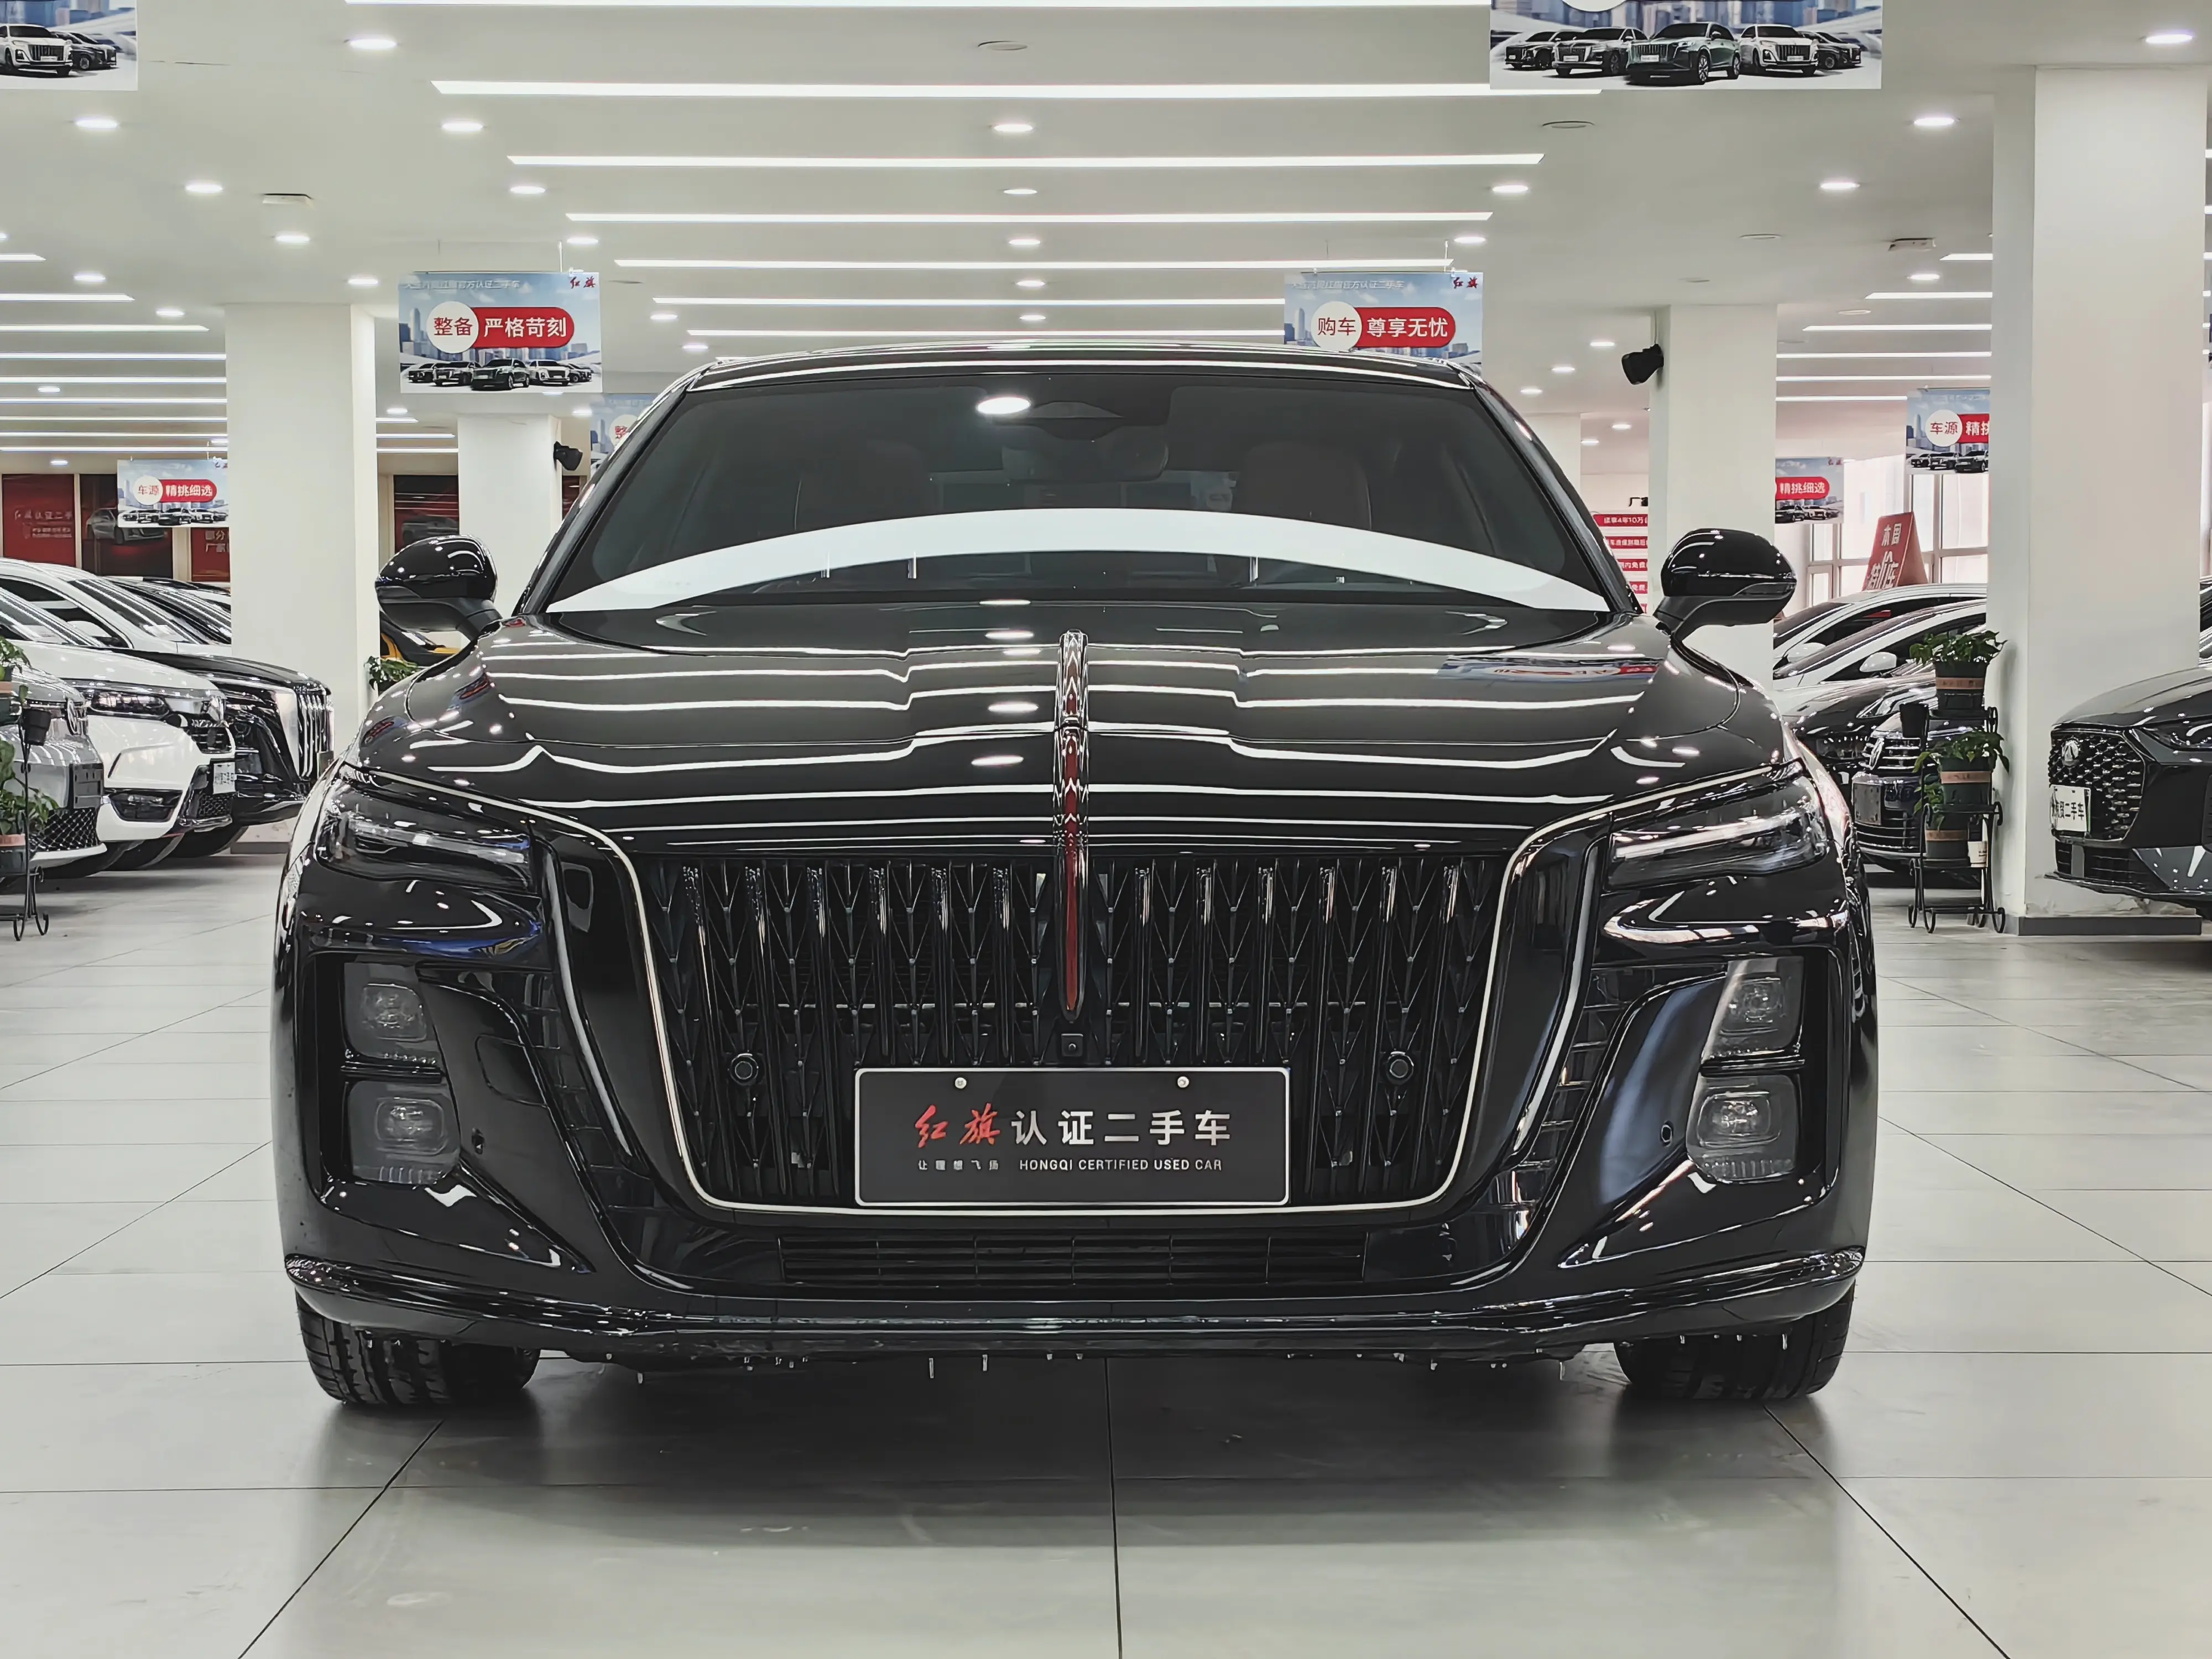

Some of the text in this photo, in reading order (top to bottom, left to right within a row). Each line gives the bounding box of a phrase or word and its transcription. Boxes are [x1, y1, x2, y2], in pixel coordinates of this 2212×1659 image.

[434, 317, 567, 337] 整备 严格苛刻
[1318, 316, 1448, 337] 购车 尊享无忧
[1930, 421, 1958, 435] 车源
[165, 484, 213, 497] 精挑细选
[1780, 482, 1825, 494] 精挑细选
[915, 1103, 1230, 1148] 红旗认证二手车
[1020, 1159, 1222, 1171] HONGQI CERTIFIED USED CAR
